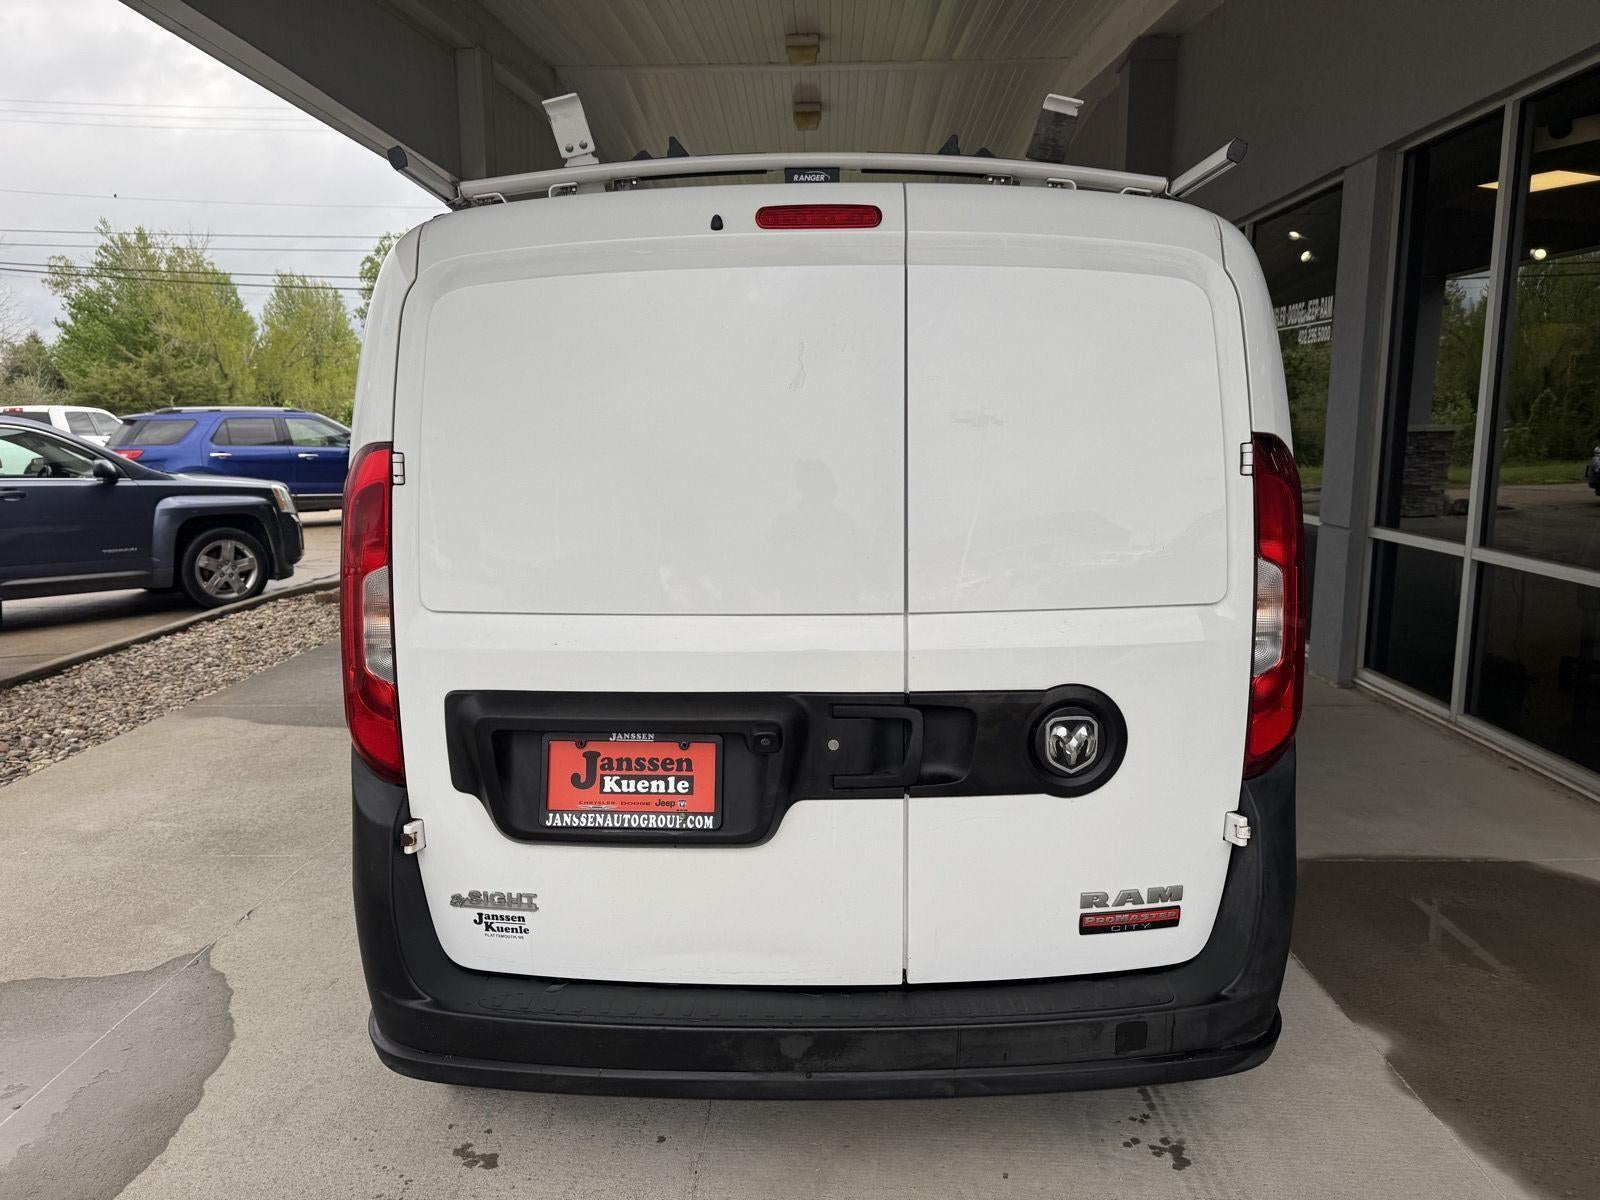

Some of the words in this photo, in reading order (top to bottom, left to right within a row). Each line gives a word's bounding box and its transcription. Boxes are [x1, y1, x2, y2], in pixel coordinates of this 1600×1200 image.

[793, 174, 826, 182] RANGER
[609, 732, 655, 742] JANSSEN
[570, 750, 694, 790] Janssen
[602, 775, 690, 794] Kuenle
[655, 798, 676, 808] Jeep
[1079, 884, 1184, 909] RAM
[473, 912, 526, 925] Janssen
[483, 922, 530, 935] Kuenle
[1110, 922, 1152, 932] CITY
